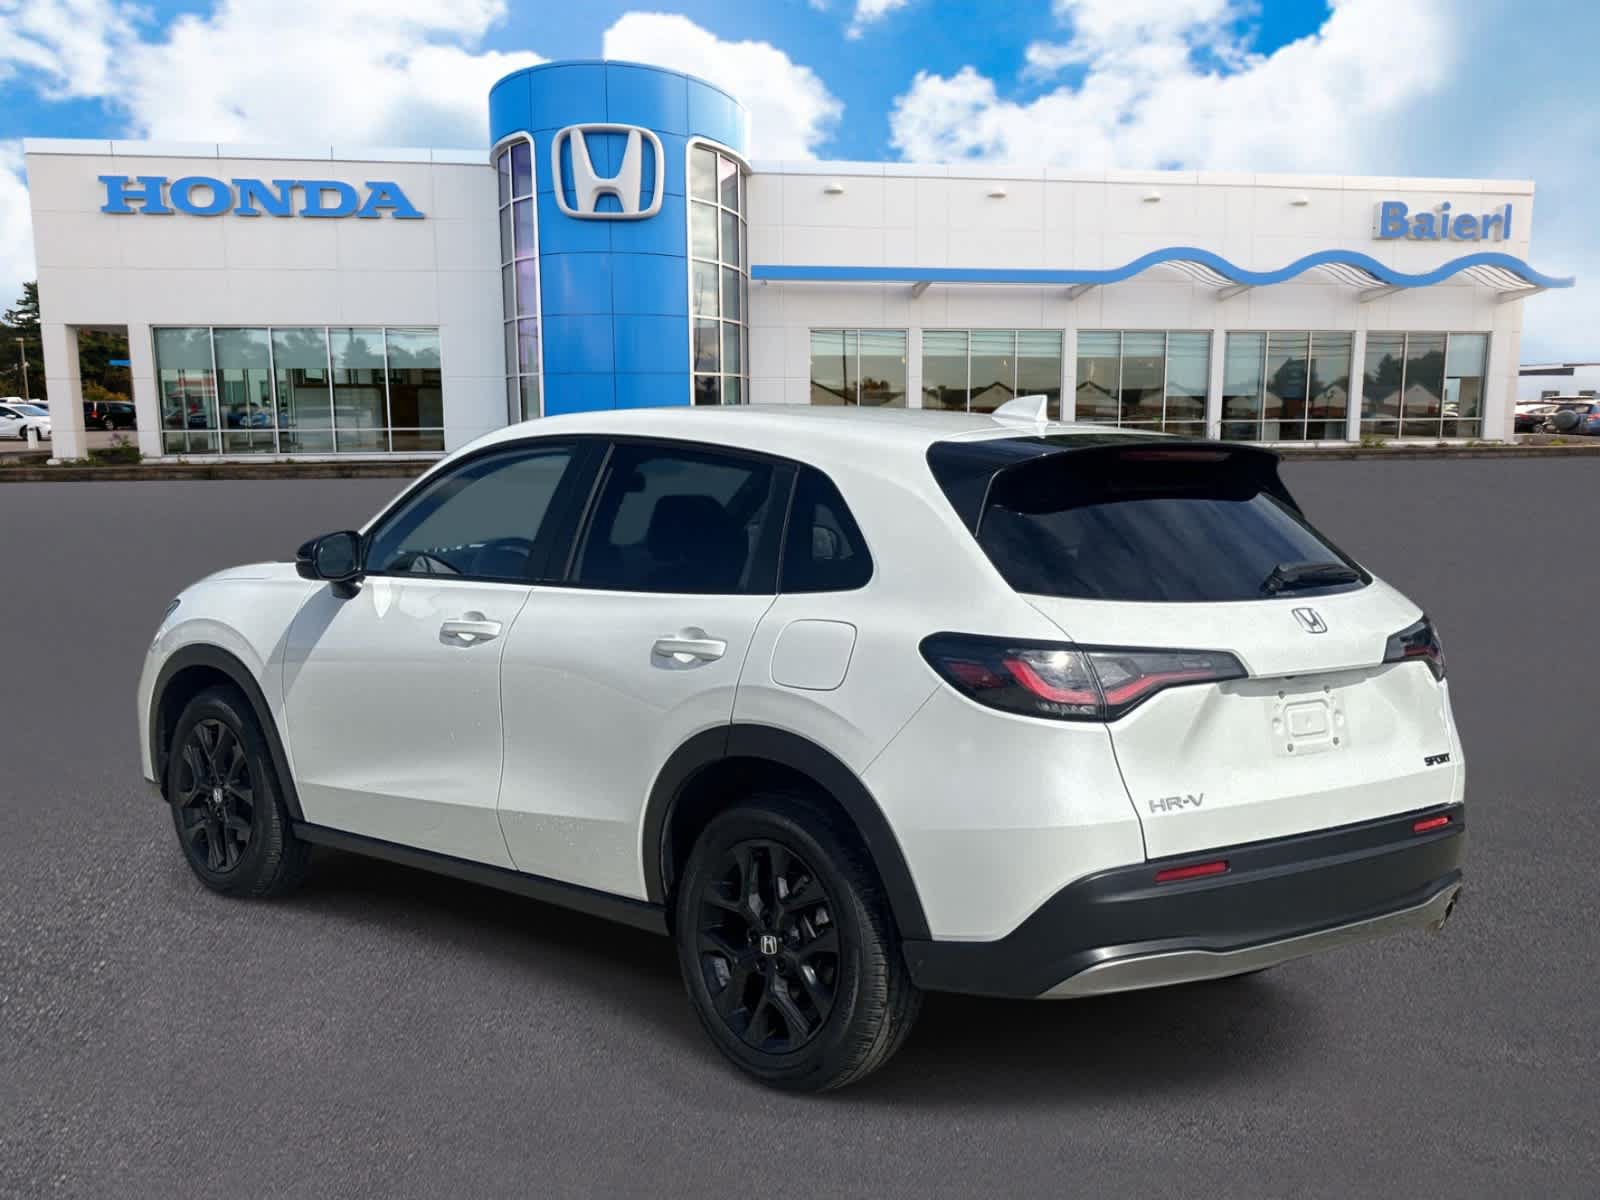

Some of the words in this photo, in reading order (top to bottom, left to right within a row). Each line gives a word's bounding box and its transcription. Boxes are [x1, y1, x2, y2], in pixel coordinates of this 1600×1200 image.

[98, 175, 426, 219] HONDA
[1379, 200, 1513, 241] Baierl
[1424, 752, 1450, 767] SPORT
[1148, 792, 1204, 813] HR-V
